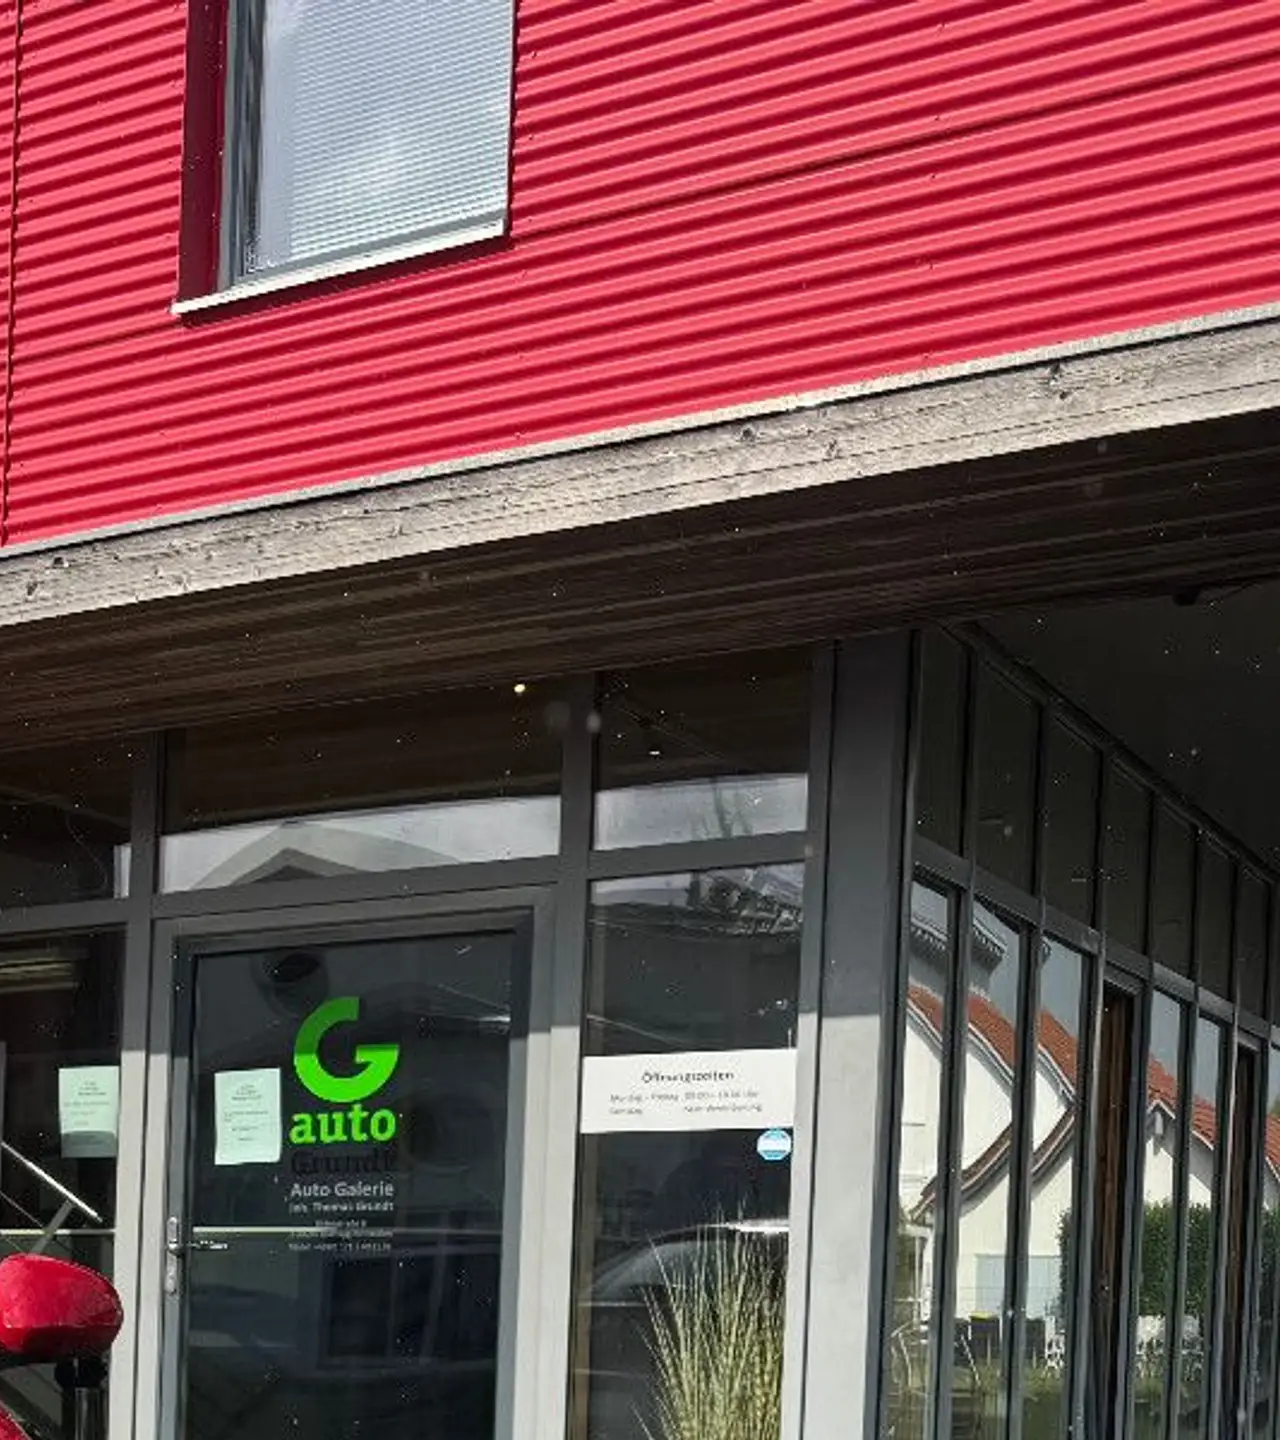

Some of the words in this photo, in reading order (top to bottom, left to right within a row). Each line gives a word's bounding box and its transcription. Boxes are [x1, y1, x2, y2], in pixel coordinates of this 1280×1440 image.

[290, 1103, 397, 1144] auto
[291, 1182, 331, 1198] Auto
[334, 1179, 395, 1197] Galerie
